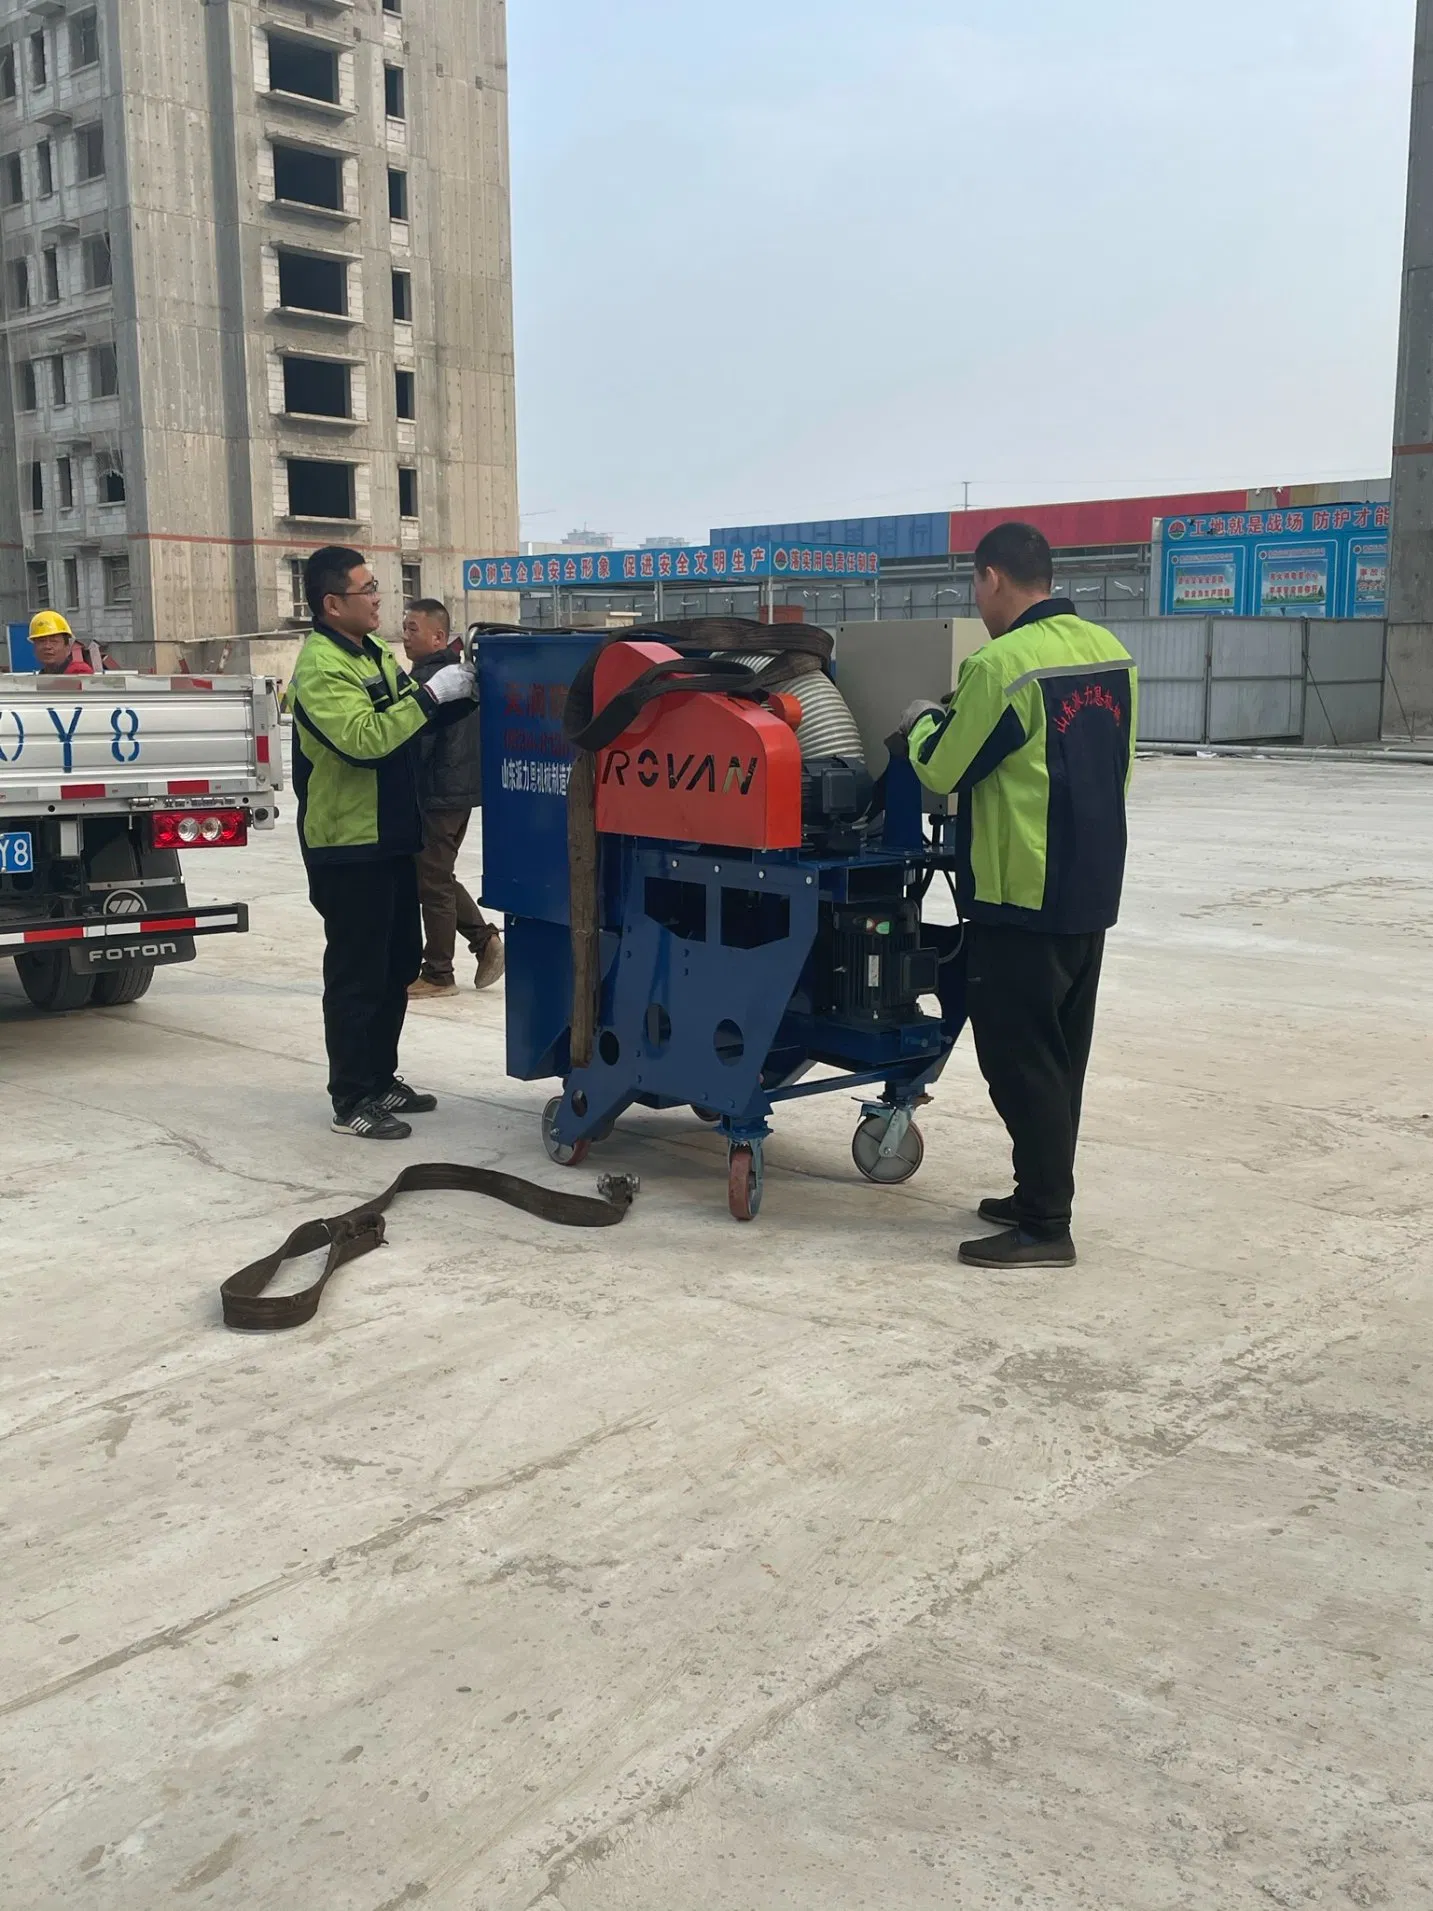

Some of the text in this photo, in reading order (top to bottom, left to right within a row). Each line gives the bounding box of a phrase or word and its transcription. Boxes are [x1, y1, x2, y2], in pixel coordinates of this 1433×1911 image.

[1190, 506, 1389, 537] 工地就是战场 防护才能
[485, 546, 766, 585] 树立企业安全形象 促进安全文明生产
[790, 547, 879, 574] 落实用电责任制度
[601, 748, 758, 795] ROVAN
[89, 942, 177, 964] FOTON
